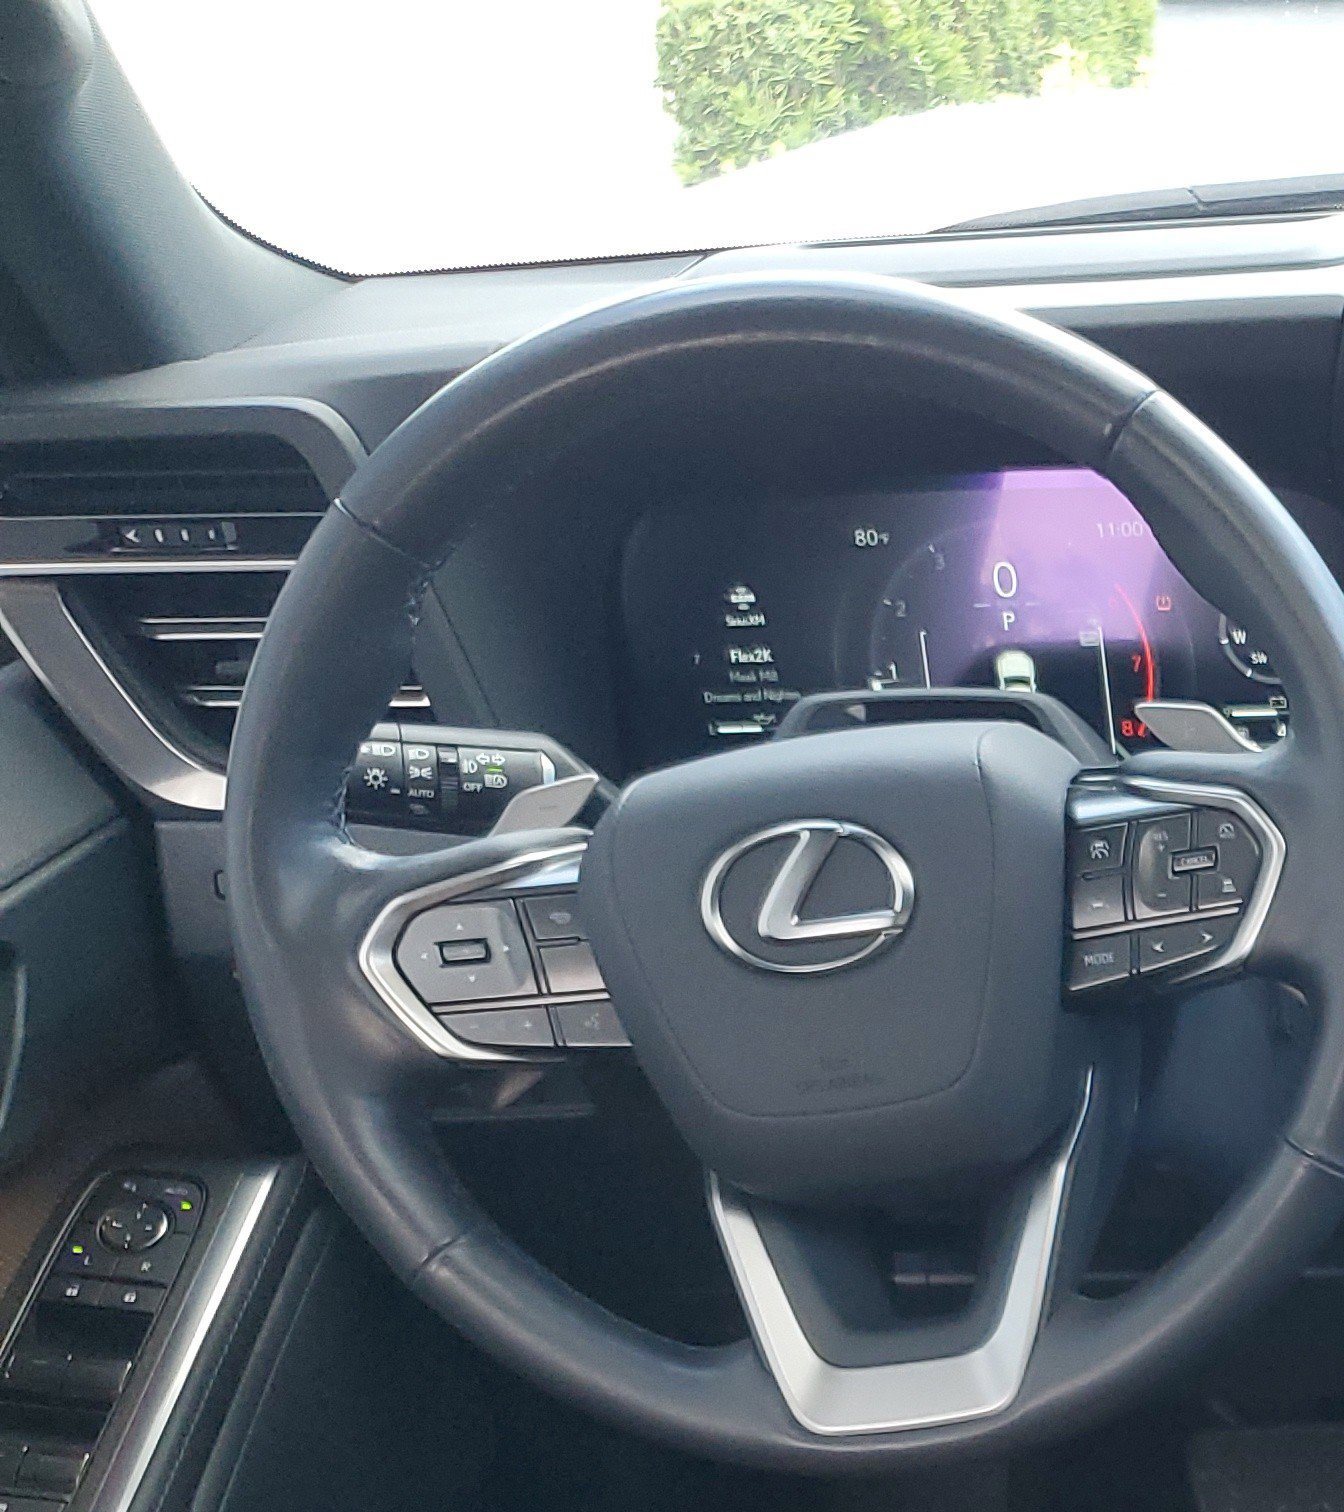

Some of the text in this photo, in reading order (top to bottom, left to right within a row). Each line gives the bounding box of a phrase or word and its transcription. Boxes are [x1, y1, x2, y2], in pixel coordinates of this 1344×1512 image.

[1096, 521, 1144, 538] 11:00
[1002, 611, 1016, 631] P
[1232, 630, 1247, 645] W
[1250, 651, 1268, 664] SW
[407, 789, 435, 798] AUTO
